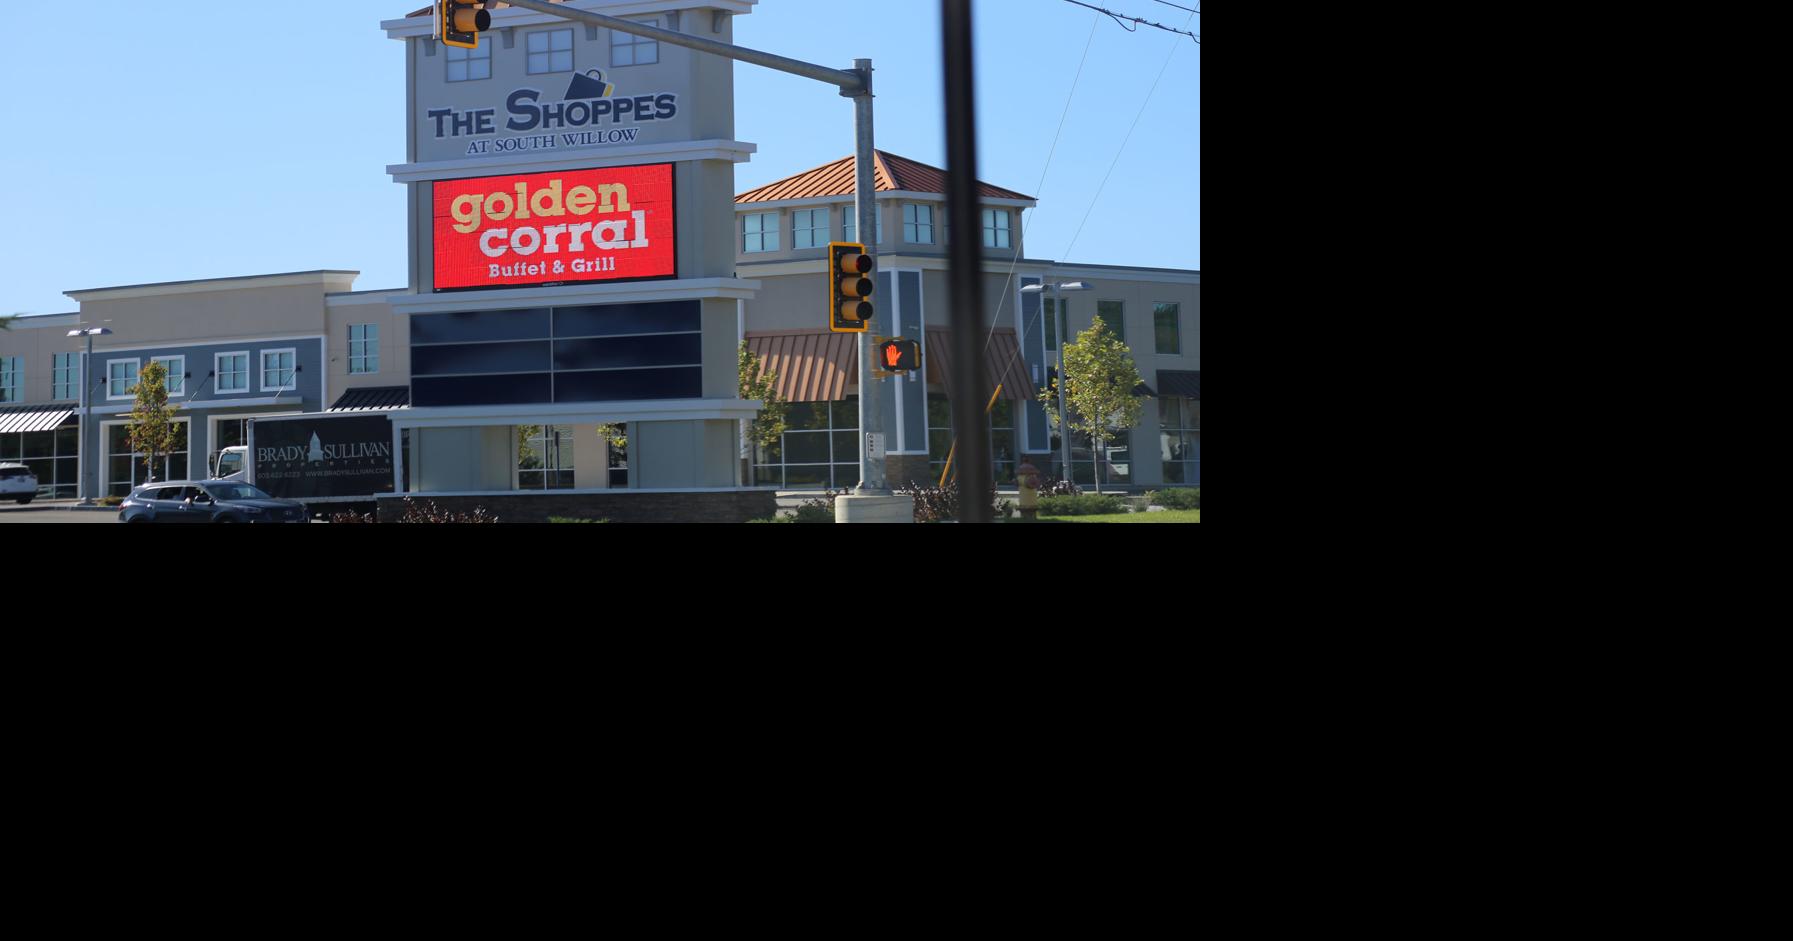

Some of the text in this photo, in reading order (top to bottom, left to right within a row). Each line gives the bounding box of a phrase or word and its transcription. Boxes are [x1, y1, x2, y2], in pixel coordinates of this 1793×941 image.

[428, 89, 679, 138] THE SHOPPES
[467, 128, 639, 154] AT SOUTH WILLOW
[451, 179, 631, 234] golden
[479, 210, 649, 257] corral
[488, 257, 616, 278] Buffet & Grill
[257, 441, 391, 462] BRADY SULLIVAN
